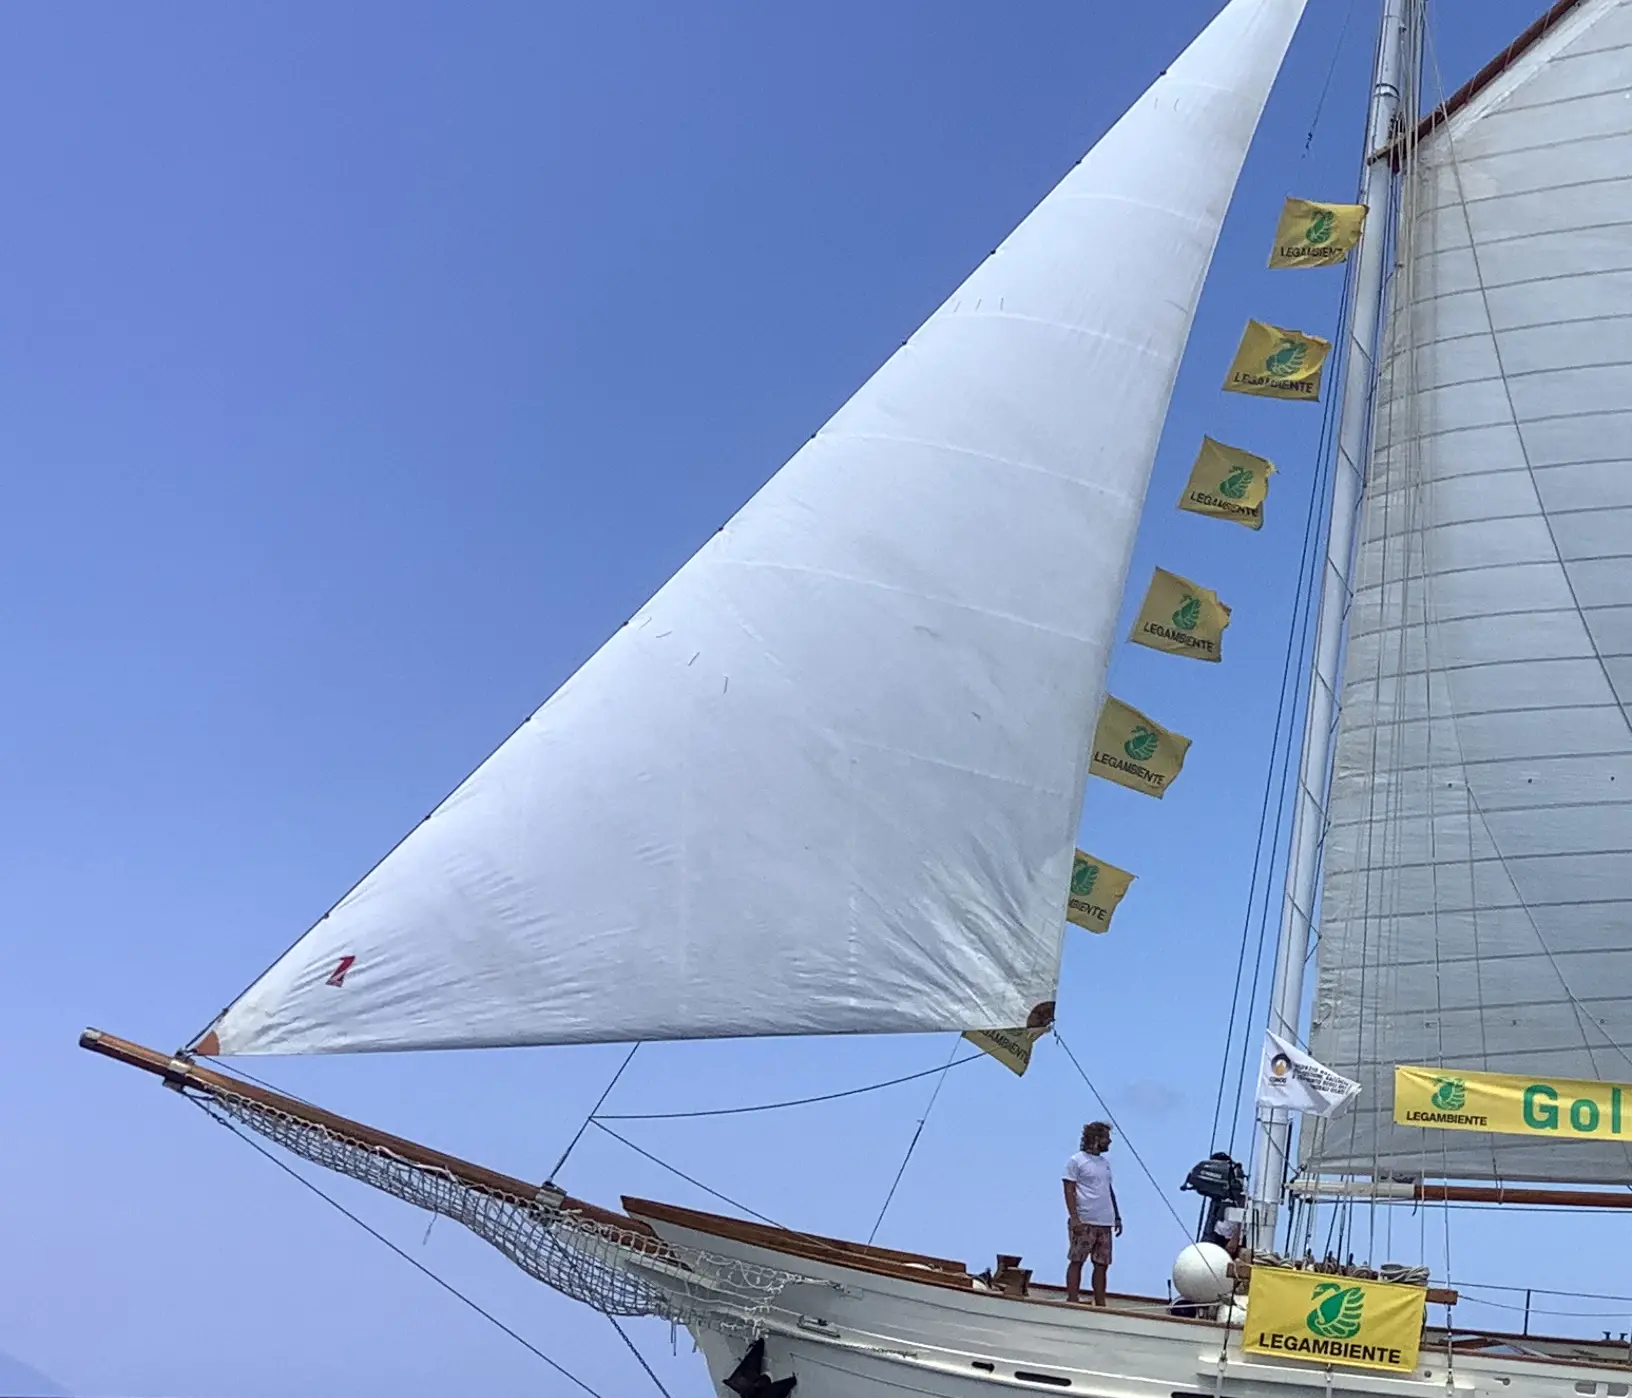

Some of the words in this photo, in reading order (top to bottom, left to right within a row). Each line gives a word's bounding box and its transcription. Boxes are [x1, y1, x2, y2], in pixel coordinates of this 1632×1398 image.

[1144, 622, 1215, 653] LEGAMBIENTE
[1094, 751, 1165, 785] LEGAMBIENTE
[1406, 1110, 1487, 1127] LEGAMBIENTE
[1259, 1332, 1402, 1364] LEGAMBIENTE
